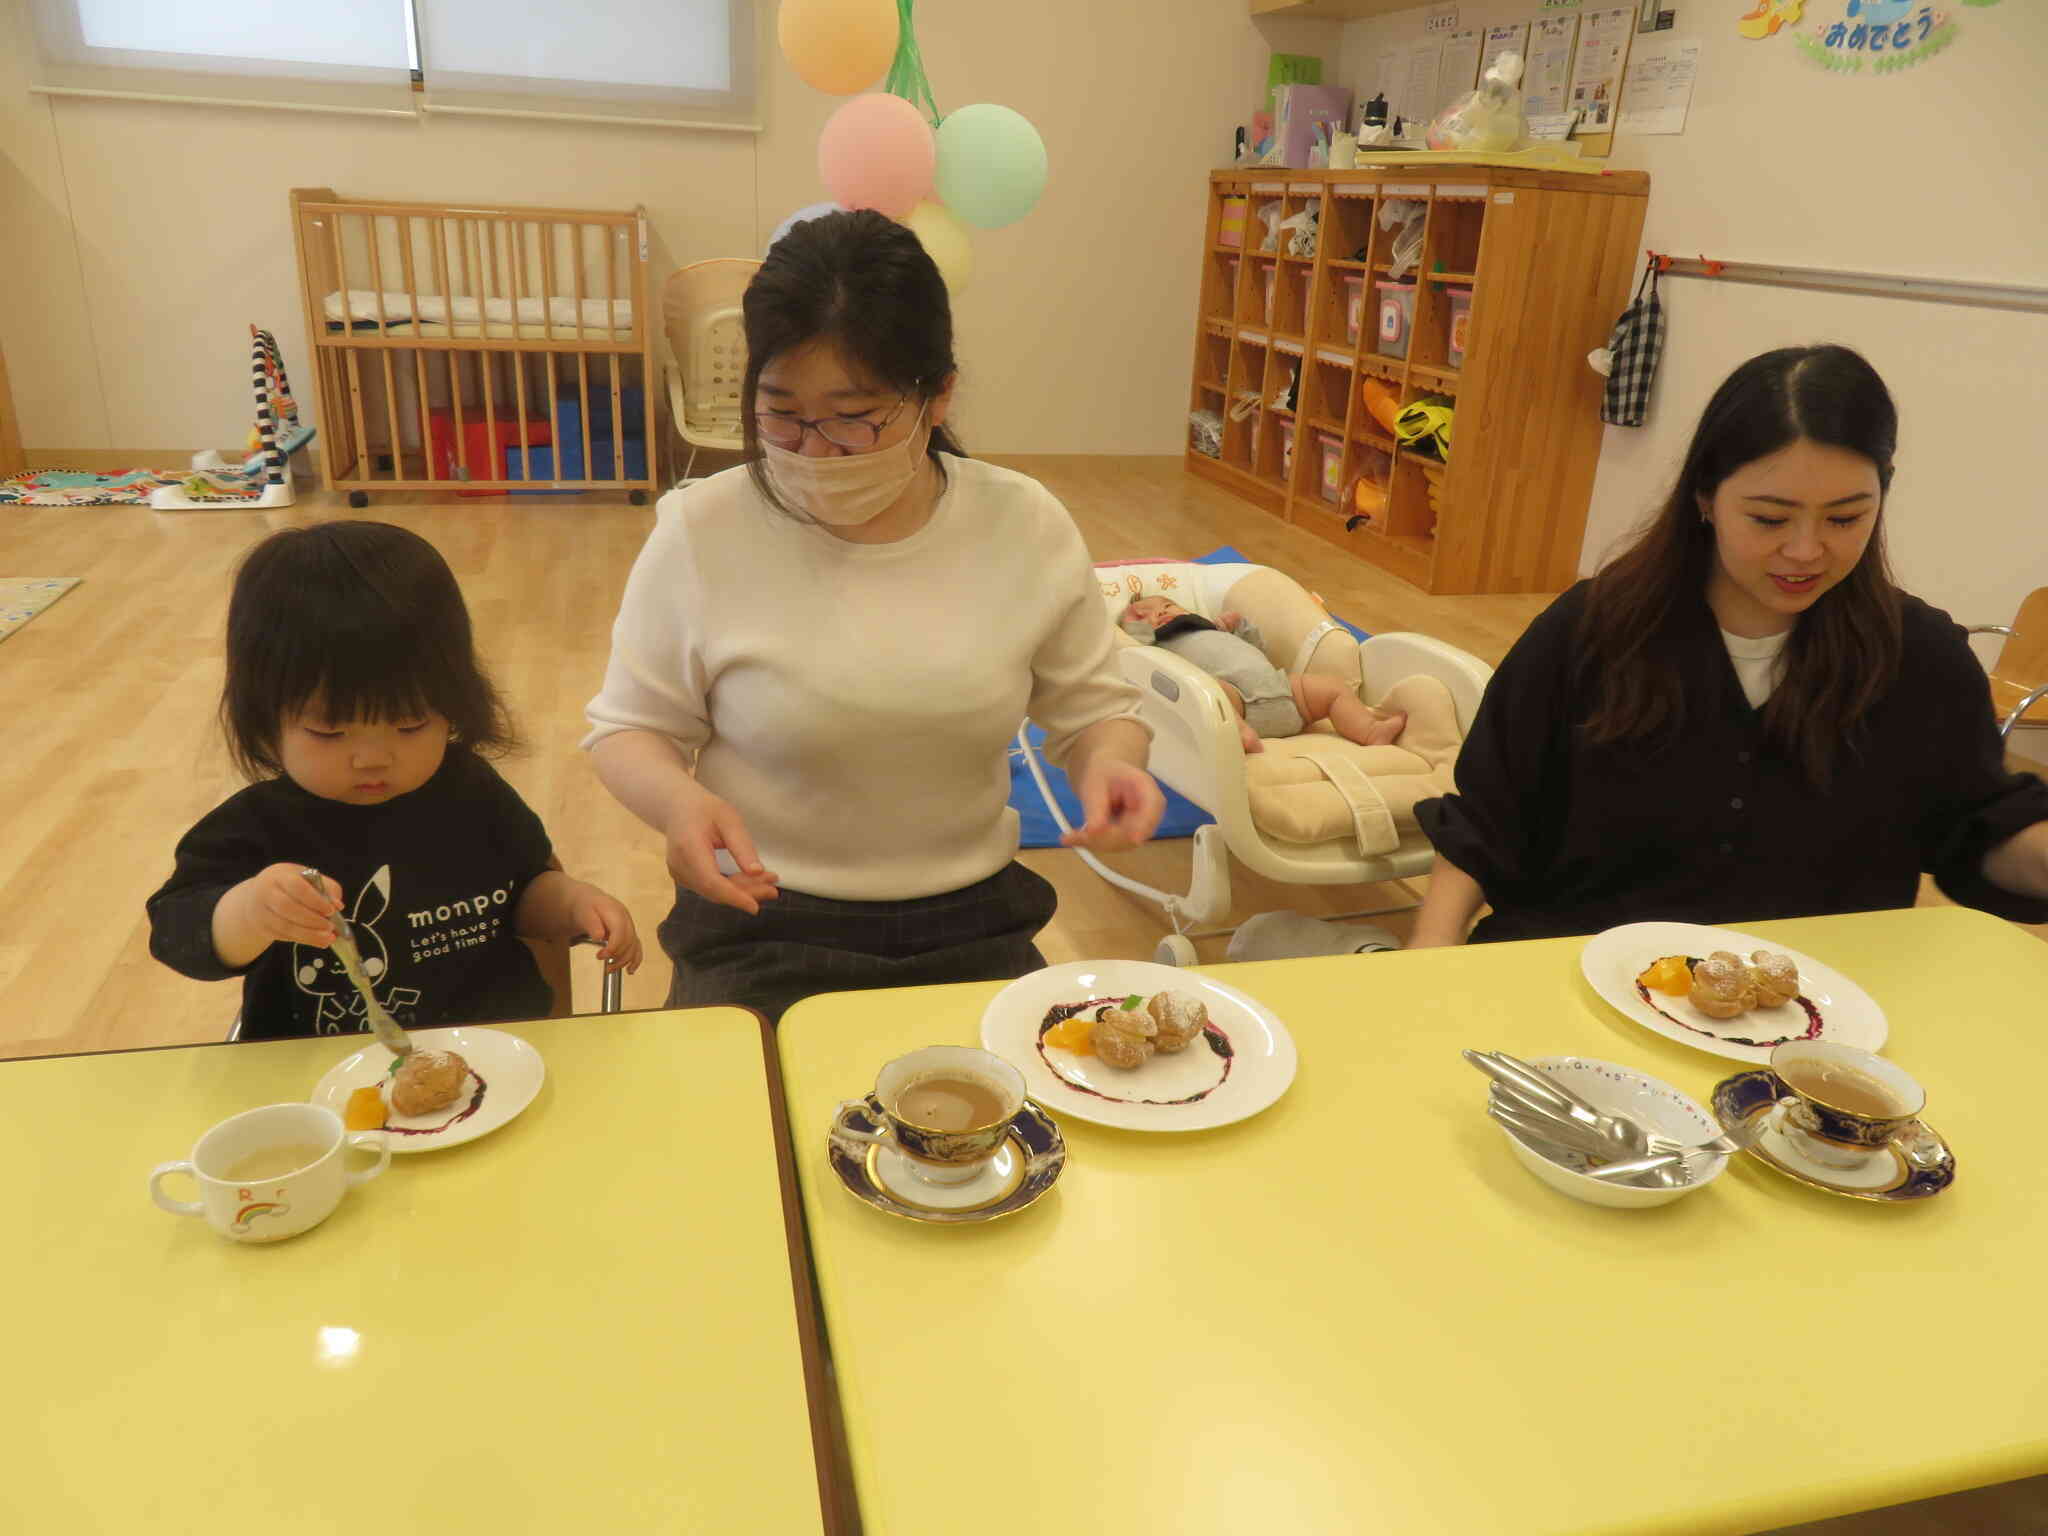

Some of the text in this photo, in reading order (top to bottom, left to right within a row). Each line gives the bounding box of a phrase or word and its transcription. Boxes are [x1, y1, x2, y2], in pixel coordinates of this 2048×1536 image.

[1825, 7, 1934, 51] おめでとう
[407, 880, 514, 928] monpo
[410, 918, 501, 949] Let's have a
[412, 943, 450, 964] good
